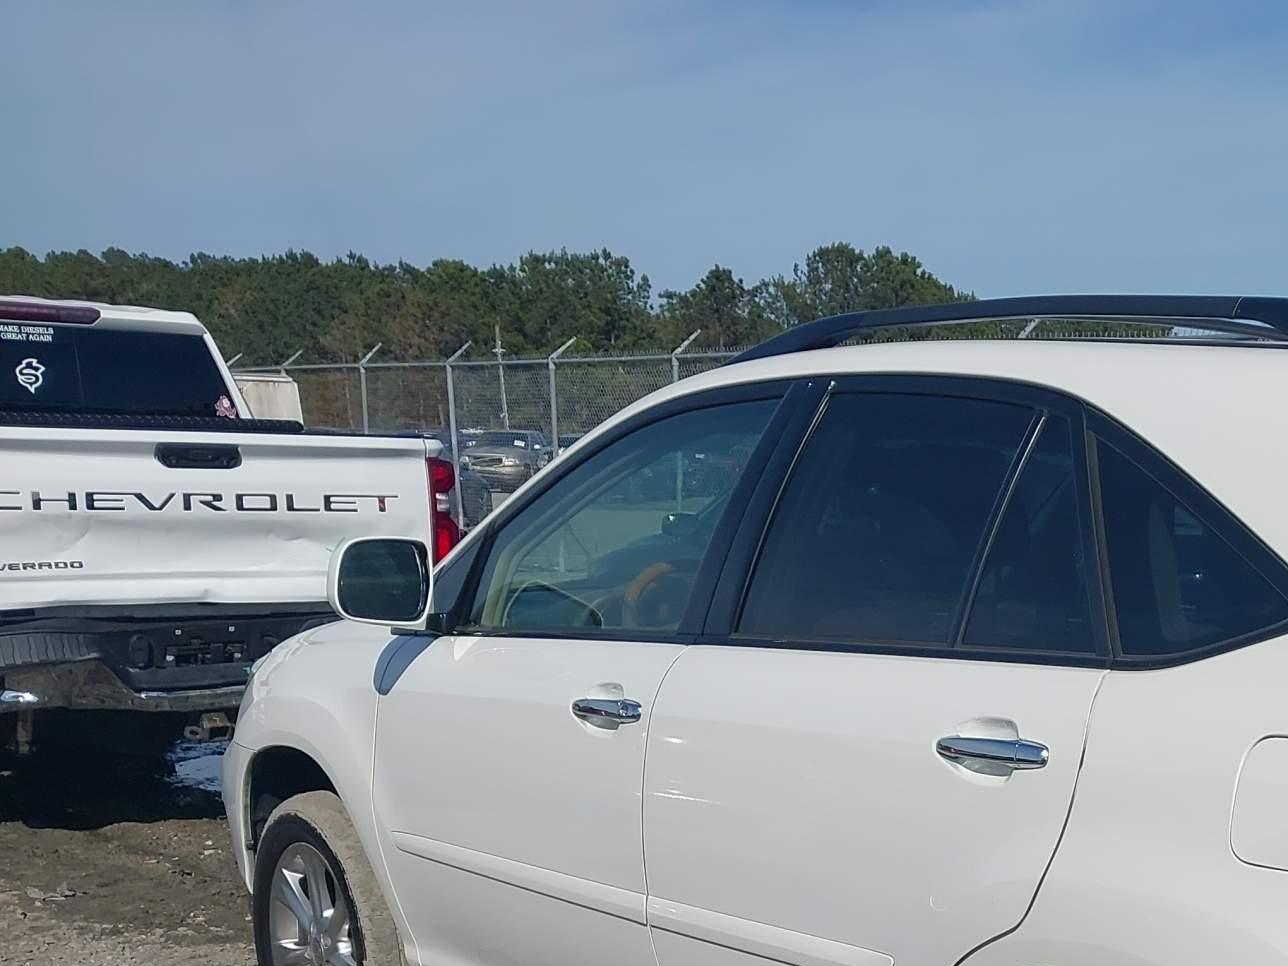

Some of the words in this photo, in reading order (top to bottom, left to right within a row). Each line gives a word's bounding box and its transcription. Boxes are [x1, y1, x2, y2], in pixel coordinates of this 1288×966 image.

[20, 326, 54, 335] DIESELS
[1, 332, 27, 341] GREAT
[29, 334, 53, 342] AGAIN
